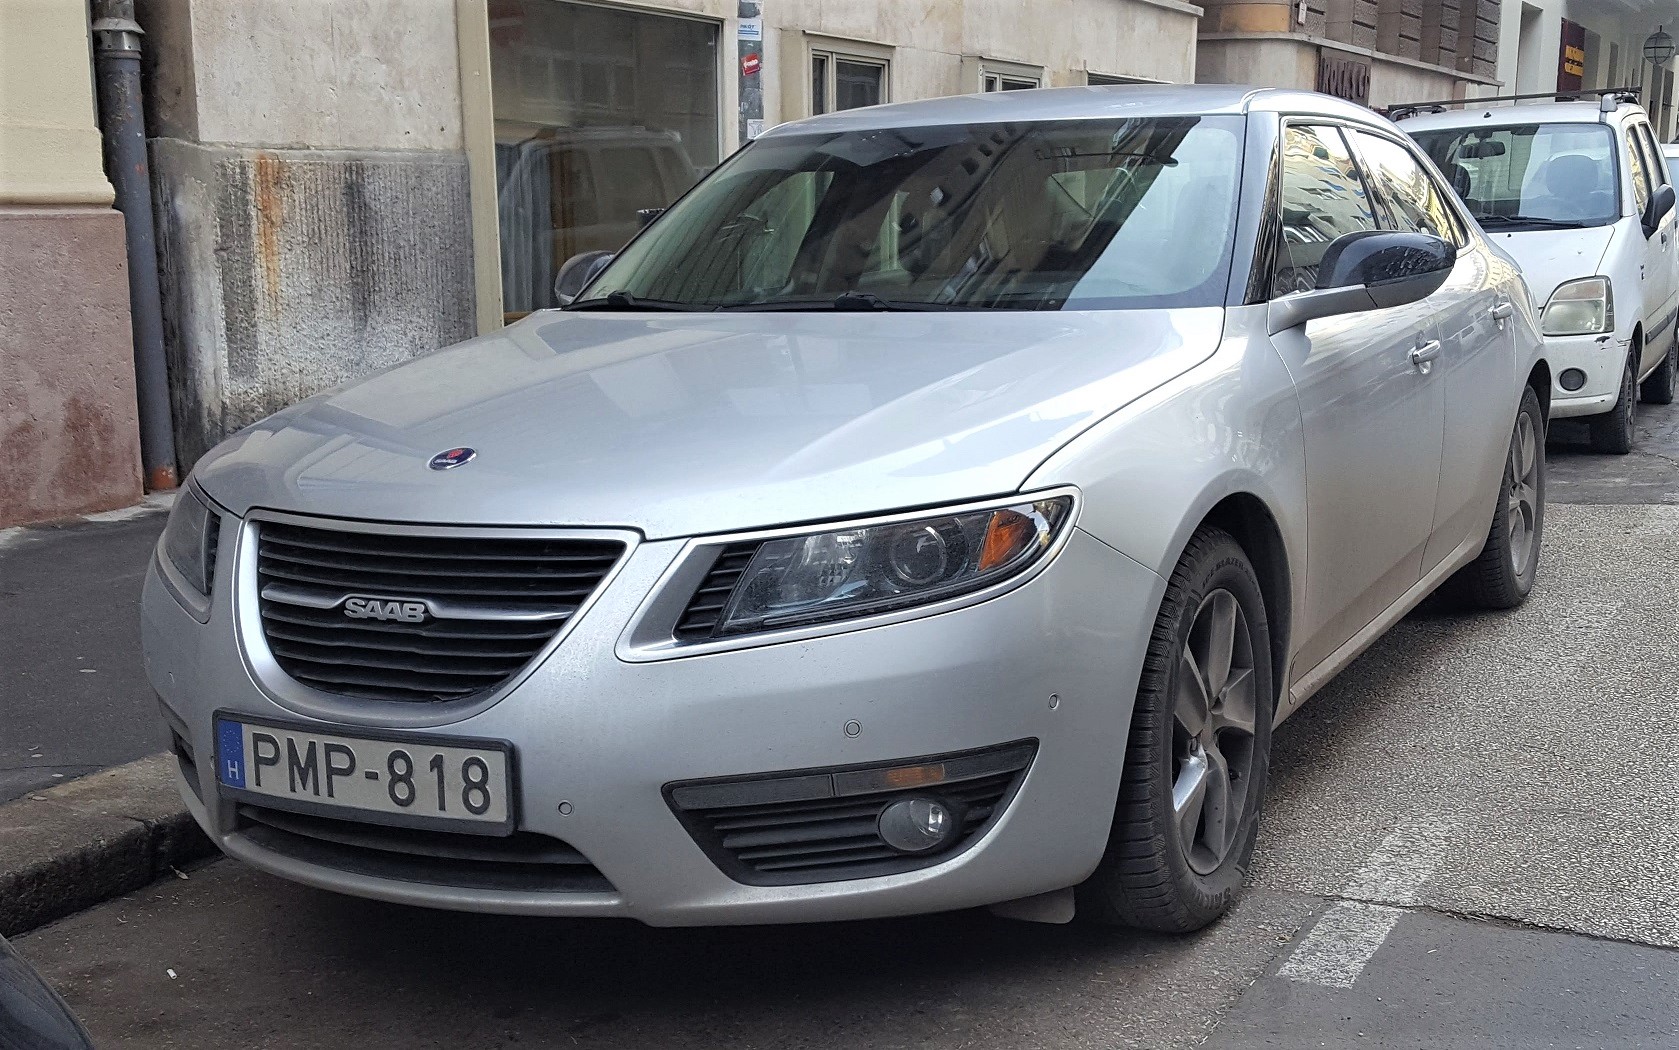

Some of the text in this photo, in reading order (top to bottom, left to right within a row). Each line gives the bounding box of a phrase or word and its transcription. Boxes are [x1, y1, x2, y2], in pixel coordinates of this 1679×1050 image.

[343, 597, 426, 623] SAAB
[227, 759, 239, 780] H
[251, 731, 491, 815] PMP-818
